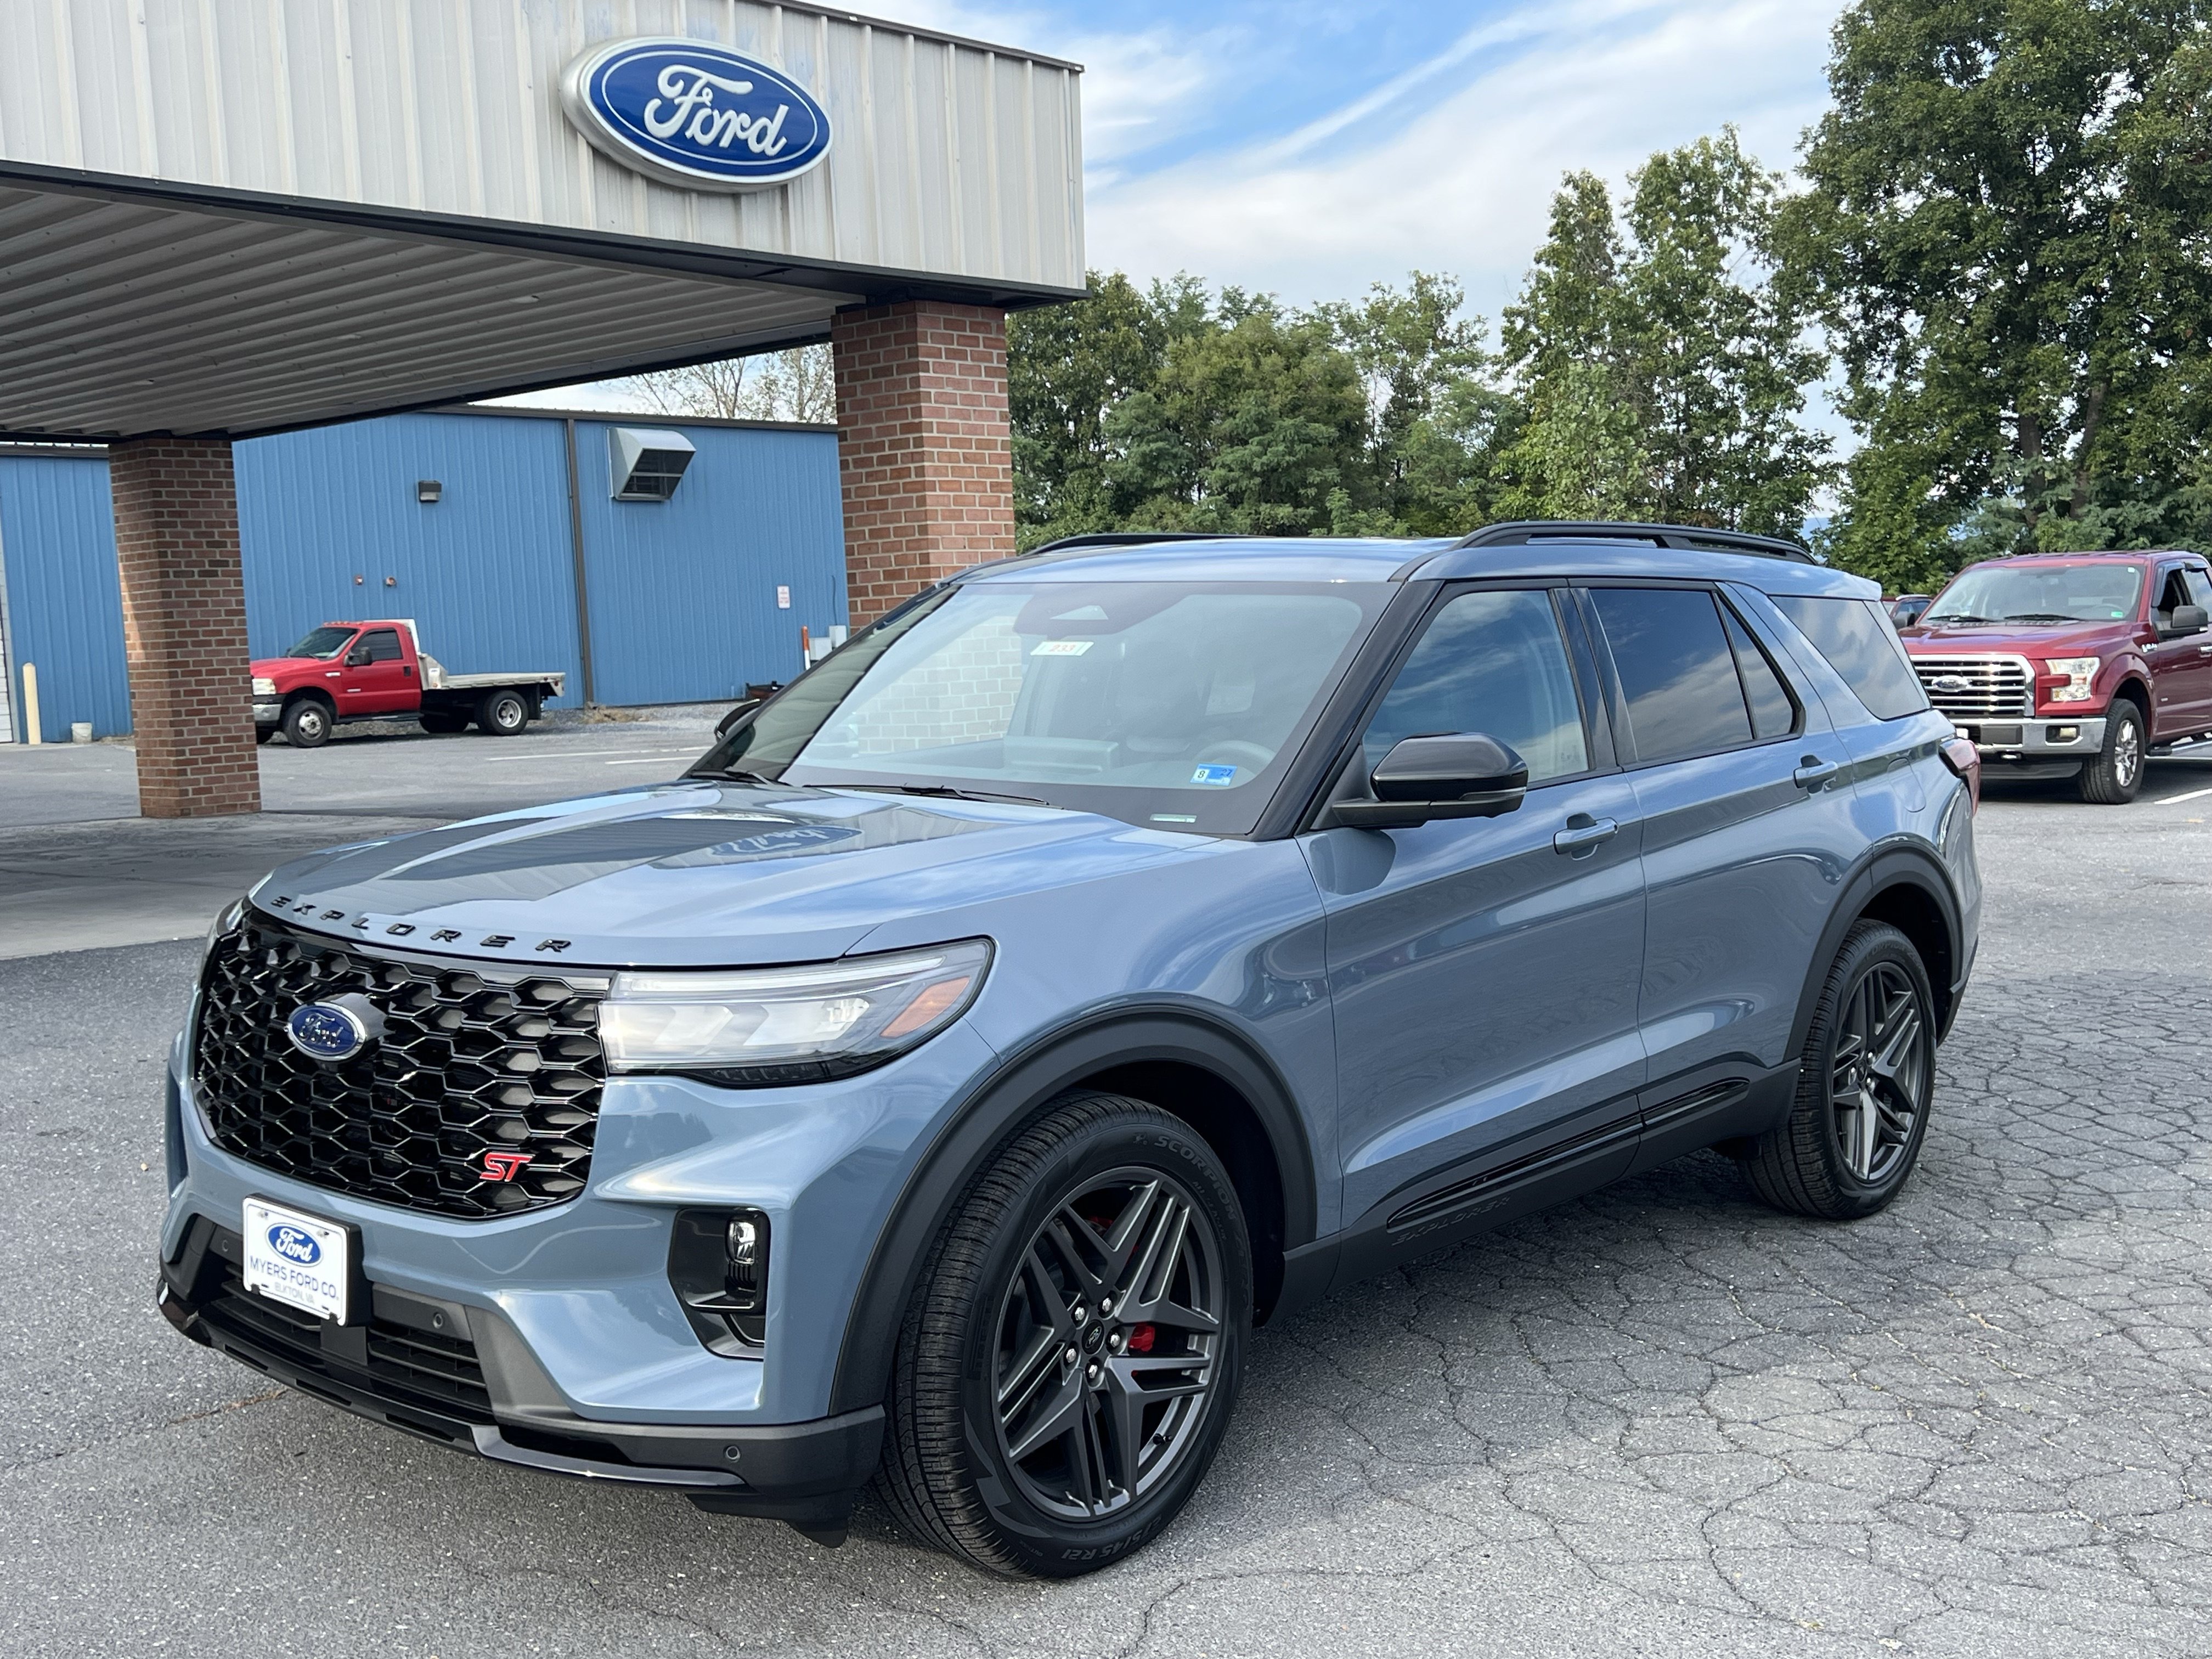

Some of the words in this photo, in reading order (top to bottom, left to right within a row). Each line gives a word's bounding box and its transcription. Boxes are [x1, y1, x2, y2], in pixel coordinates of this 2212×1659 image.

[644, 64, 789, 156] Ford
[270, 895, 572, 952] EXPLORER
[479, 1151, 535, 1182] ST
[1154, 1135, 1237, 1221] SCORPION
[276, 1227, 313, 1262] Ford
[1391, 1197, 1510, 1246] EXPLORER
[250, 1255, 287, 1281] MYERS
[290, 1269, 319, 1292] FORD
[321, 1281, 340, 1301] CO.
[1060, 1548, 1098, 1560] R21
